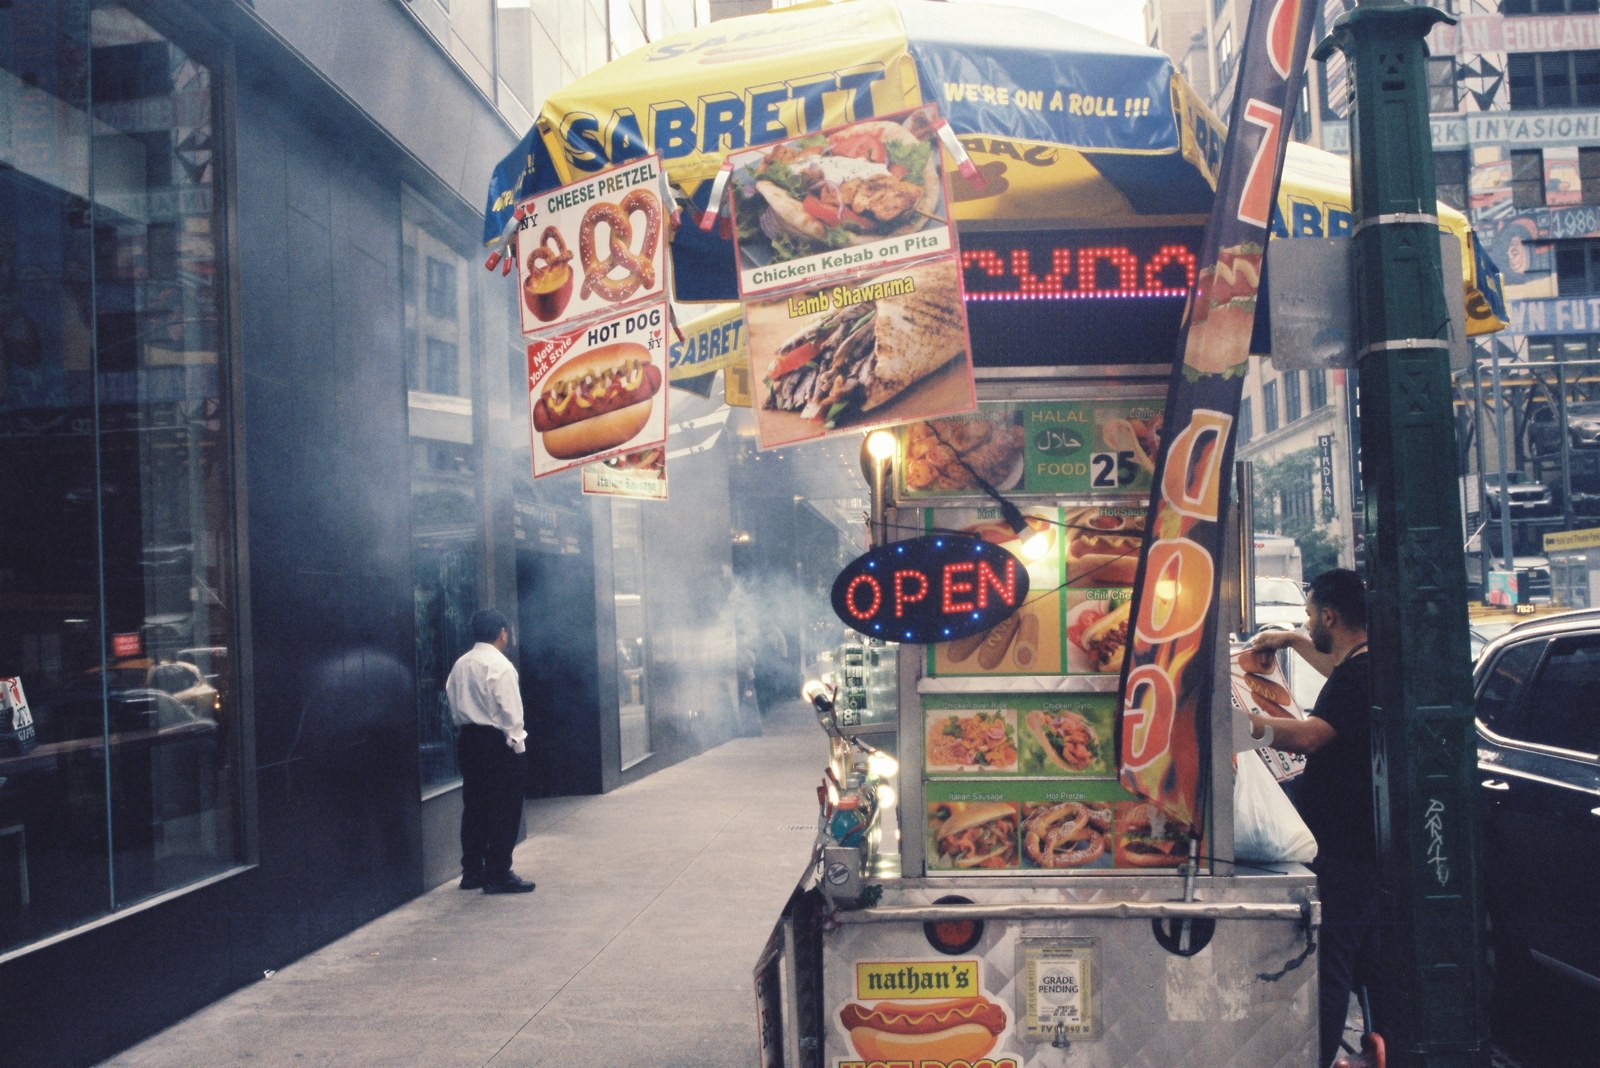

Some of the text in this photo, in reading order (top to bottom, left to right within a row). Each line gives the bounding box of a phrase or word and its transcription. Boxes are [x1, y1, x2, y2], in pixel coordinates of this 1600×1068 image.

[944, 83, 1149, 118] WE'RE ON A ROLL !!!
[560, 62, 886, 172] SABRETT
[1432, 123, 1459, 143] RK
[548, 164, 657, 213] CHEESE PRETZEL
[752, 262, 816, 285] Chicken
[822, 250, 873, 270] Kebab
[879, 242, 899, 257] on
[904, 234, 938, 252] Pita
[788, 276, 916, 318] Lamb Shawarma
[588, 322, 620, 346] HOT
[626, 309, 661, 334] DOG
[648, 338, 663, 350] NY
[669, 319, 743, 369] SABRET
[533, 340, 555, 367] New
[530, 337, 573, 385] York Style
[1031, 410, 1088, 423] HALAL
[1037, 463, 1086, 476] FOOD
[1092, 451, 1137, 487] 25
[977, 508, 997, 519] Hot
[1100, 508, 1116, 517] Hot
[845, 558, 1016, 620] OPEN
[1086, 590, 1132, 600] Chili Che
[1516, 604, 1535, 613] 7B21
[991, 701, 1008, 709] Rice
[1074, 702, 1093, 710] Gyro
[949, 792, 1004, 801] Italian Sausage
[1046, 792, 1087, 800] Hot Pretzel
[868, 965, 969, 994] nathan's
[1043, 976, 1074, 985] GRADE
[1038, 985, 1079, 994] PENDING
[1041, 1025, 1053, 1033] FV
